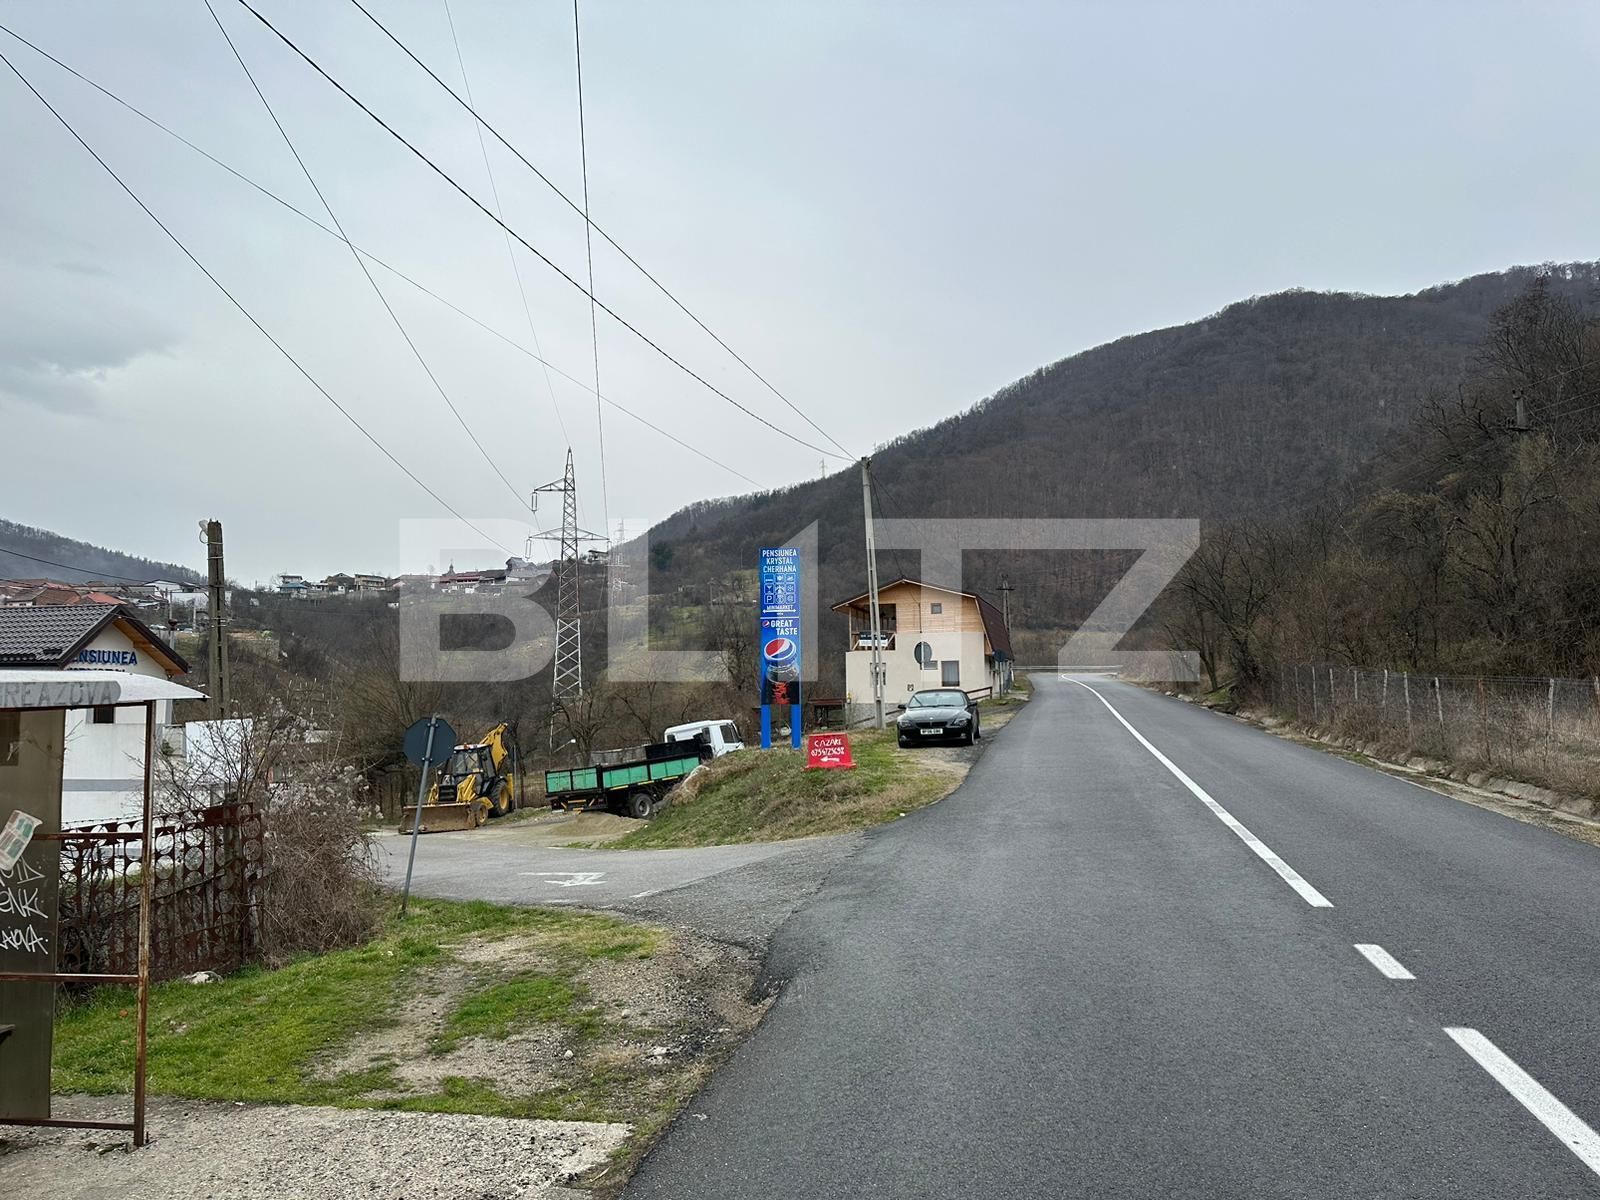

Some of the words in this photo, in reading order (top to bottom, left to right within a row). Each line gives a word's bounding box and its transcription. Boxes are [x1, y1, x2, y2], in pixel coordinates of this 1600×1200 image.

[762, 549, 797, 557] PENSIUNEA
[766, 557, 793, 565] KRYSTAL
[762, 565, 797, 573] CHERHANA
[770, 619, 794, 628] GREAT
[776, 627, 798, 636] TASTE
